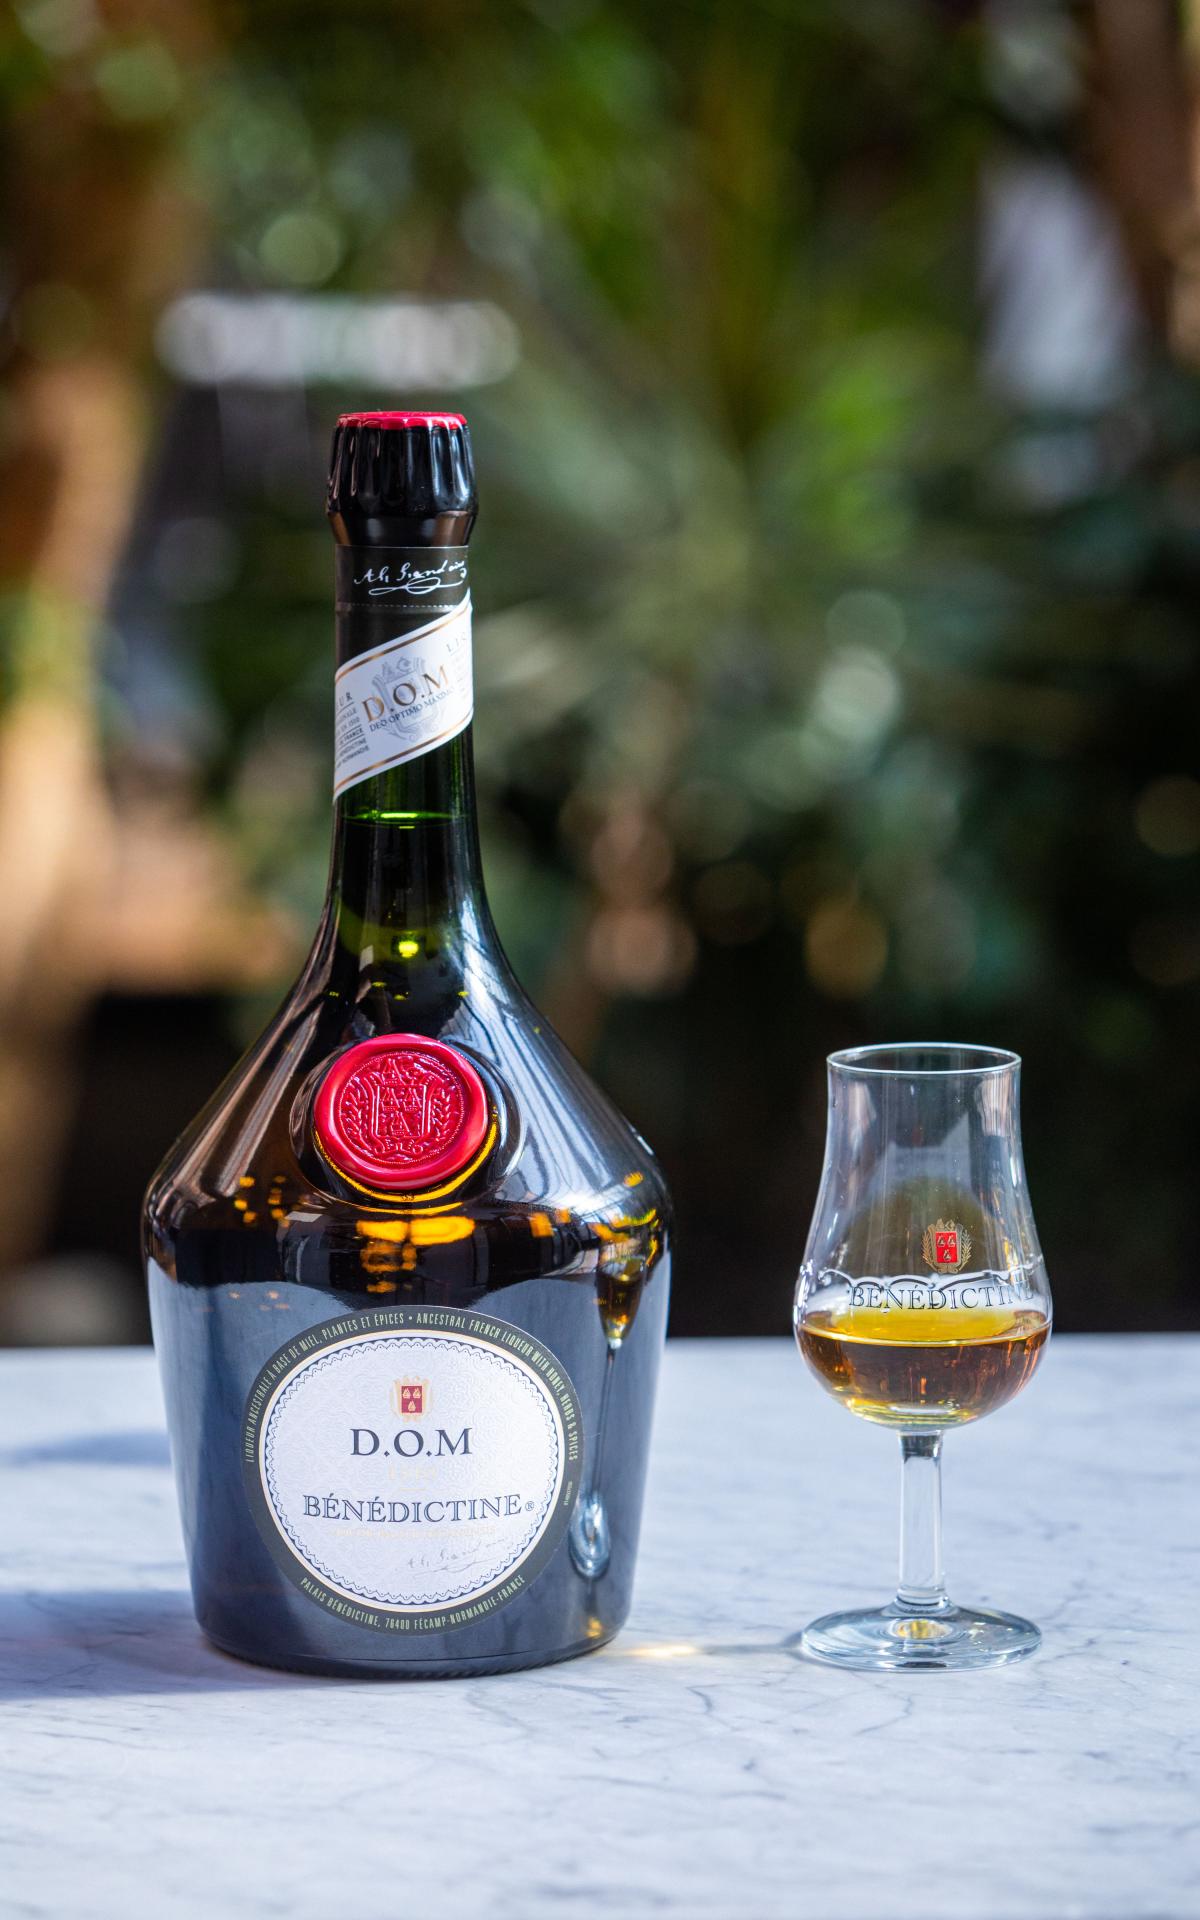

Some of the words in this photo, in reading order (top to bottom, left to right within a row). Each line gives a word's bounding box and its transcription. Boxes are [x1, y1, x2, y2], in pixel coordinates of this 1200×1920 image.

[362, 665, 449, 722] D.O.M
[369, 720, 387, 732] DEO
[389, 703, 423, 724] OPTIMO
[321, 1319, 359, 1341] PLANTES
[361, 1316, 372, 1329] ET
[374, 1312, 405, 1327] ÉPICES
[416, 1312, 466, 1329] ANCESTRAL
[468, 1319, 502, 1339] FRENCH
[288, 1345, 301, 1359] DE
[501, 1331, 534, 1357] LIQUEUR
[272, 1353, 291, 1374] BASE
[531, 1351, 551, 1372] WITH
[247, 1376, 273, 1426] ANCESTRALE
[560, 1392, 576, 1422] HERBS
[567, 1421, 577, 1430] &
[244, 1425, 256, 1463] LIQUEUR
[350, 1427, 473, 1458] D.O.M
[568, 1430, 579, 1461] SPICES
[301, 1577, 327, 1602] PALAIS
[327, 1597, 381, 1628] BÉNÉDICTINE,
[385, 1617, 410, 1631] 76400
